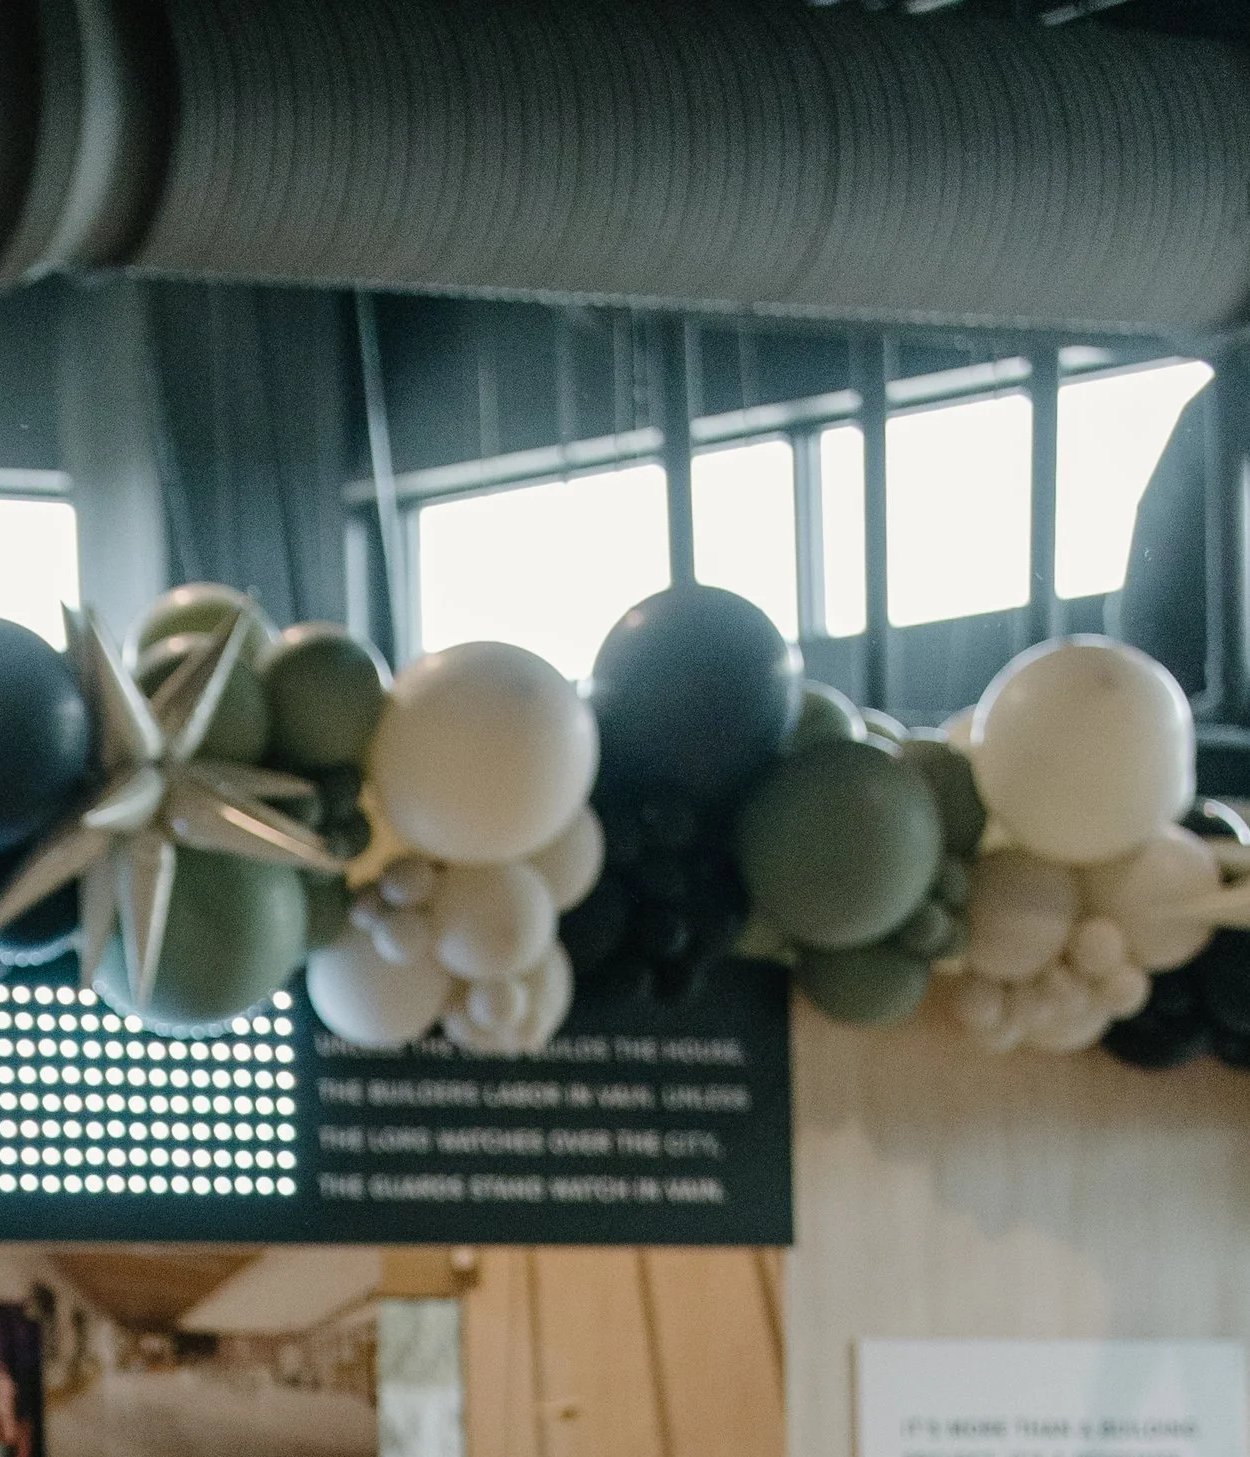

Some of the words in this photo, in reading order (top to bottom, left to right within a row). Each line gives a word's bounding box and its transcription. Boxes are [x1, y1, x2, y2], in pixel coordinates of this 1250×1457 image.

[614, 1036, 656, 1062] THE
[318, 1078, 363, 1105] THE
[367, 1079, 480, 1107] BUILDERS
[483, 1081, 563, 1108] LABOR
[568, 1083, 593, 1108] IN
[660, 1084, 749, 1112] UNLESS
[319, 1126, 364, 1153] THE
[367, 1127, 430, 1153] LORD
[435, 1127, 543, 1155] WATCHES
[550, 1128, 612, 1156] OVER
[617, 1129, 660, 1157] THE
[318, 1173, 363, 1199] THE
[367, 1174, 464, 1200] GUARDS
[469, 1175, 542, 1201] STAND
[549, 1176, 628, 1203] WATCH
[637, 1177, 662, 1203] IN
[945, 1416, 1008, 1440] MORE
[1014, 1416, 1071, 1439] THAN
